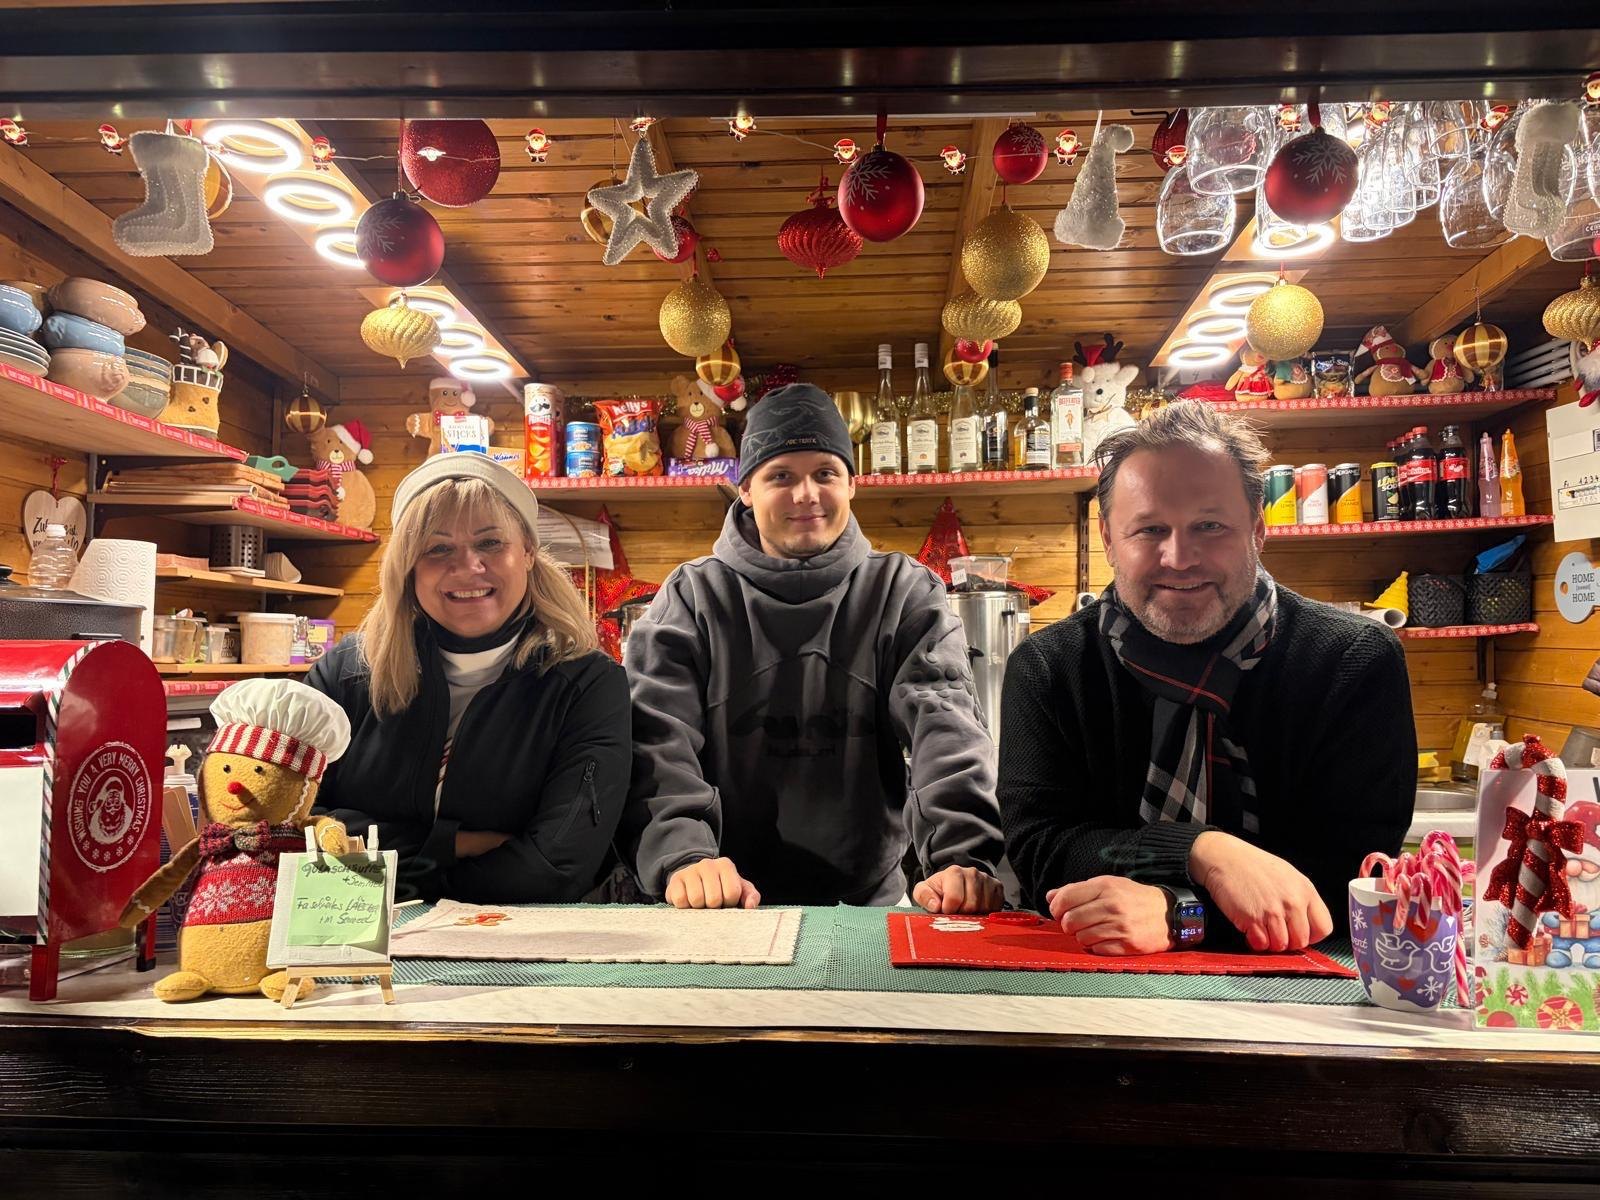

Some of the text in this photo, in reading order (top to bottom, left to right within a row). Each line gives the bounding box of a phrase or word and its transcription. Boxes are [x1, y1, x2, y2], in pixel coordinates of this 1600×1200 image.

[1058, 396, 1081, 405] BEEFEATER
[687, 460, 729, 476] Milka
[1571, 572, 1595, 584] HOME
[1572, 592, 1595, 603] HOME
[73, 752, 147, 842] WISHING YOU A VERY MERRY CHRISTMAS
